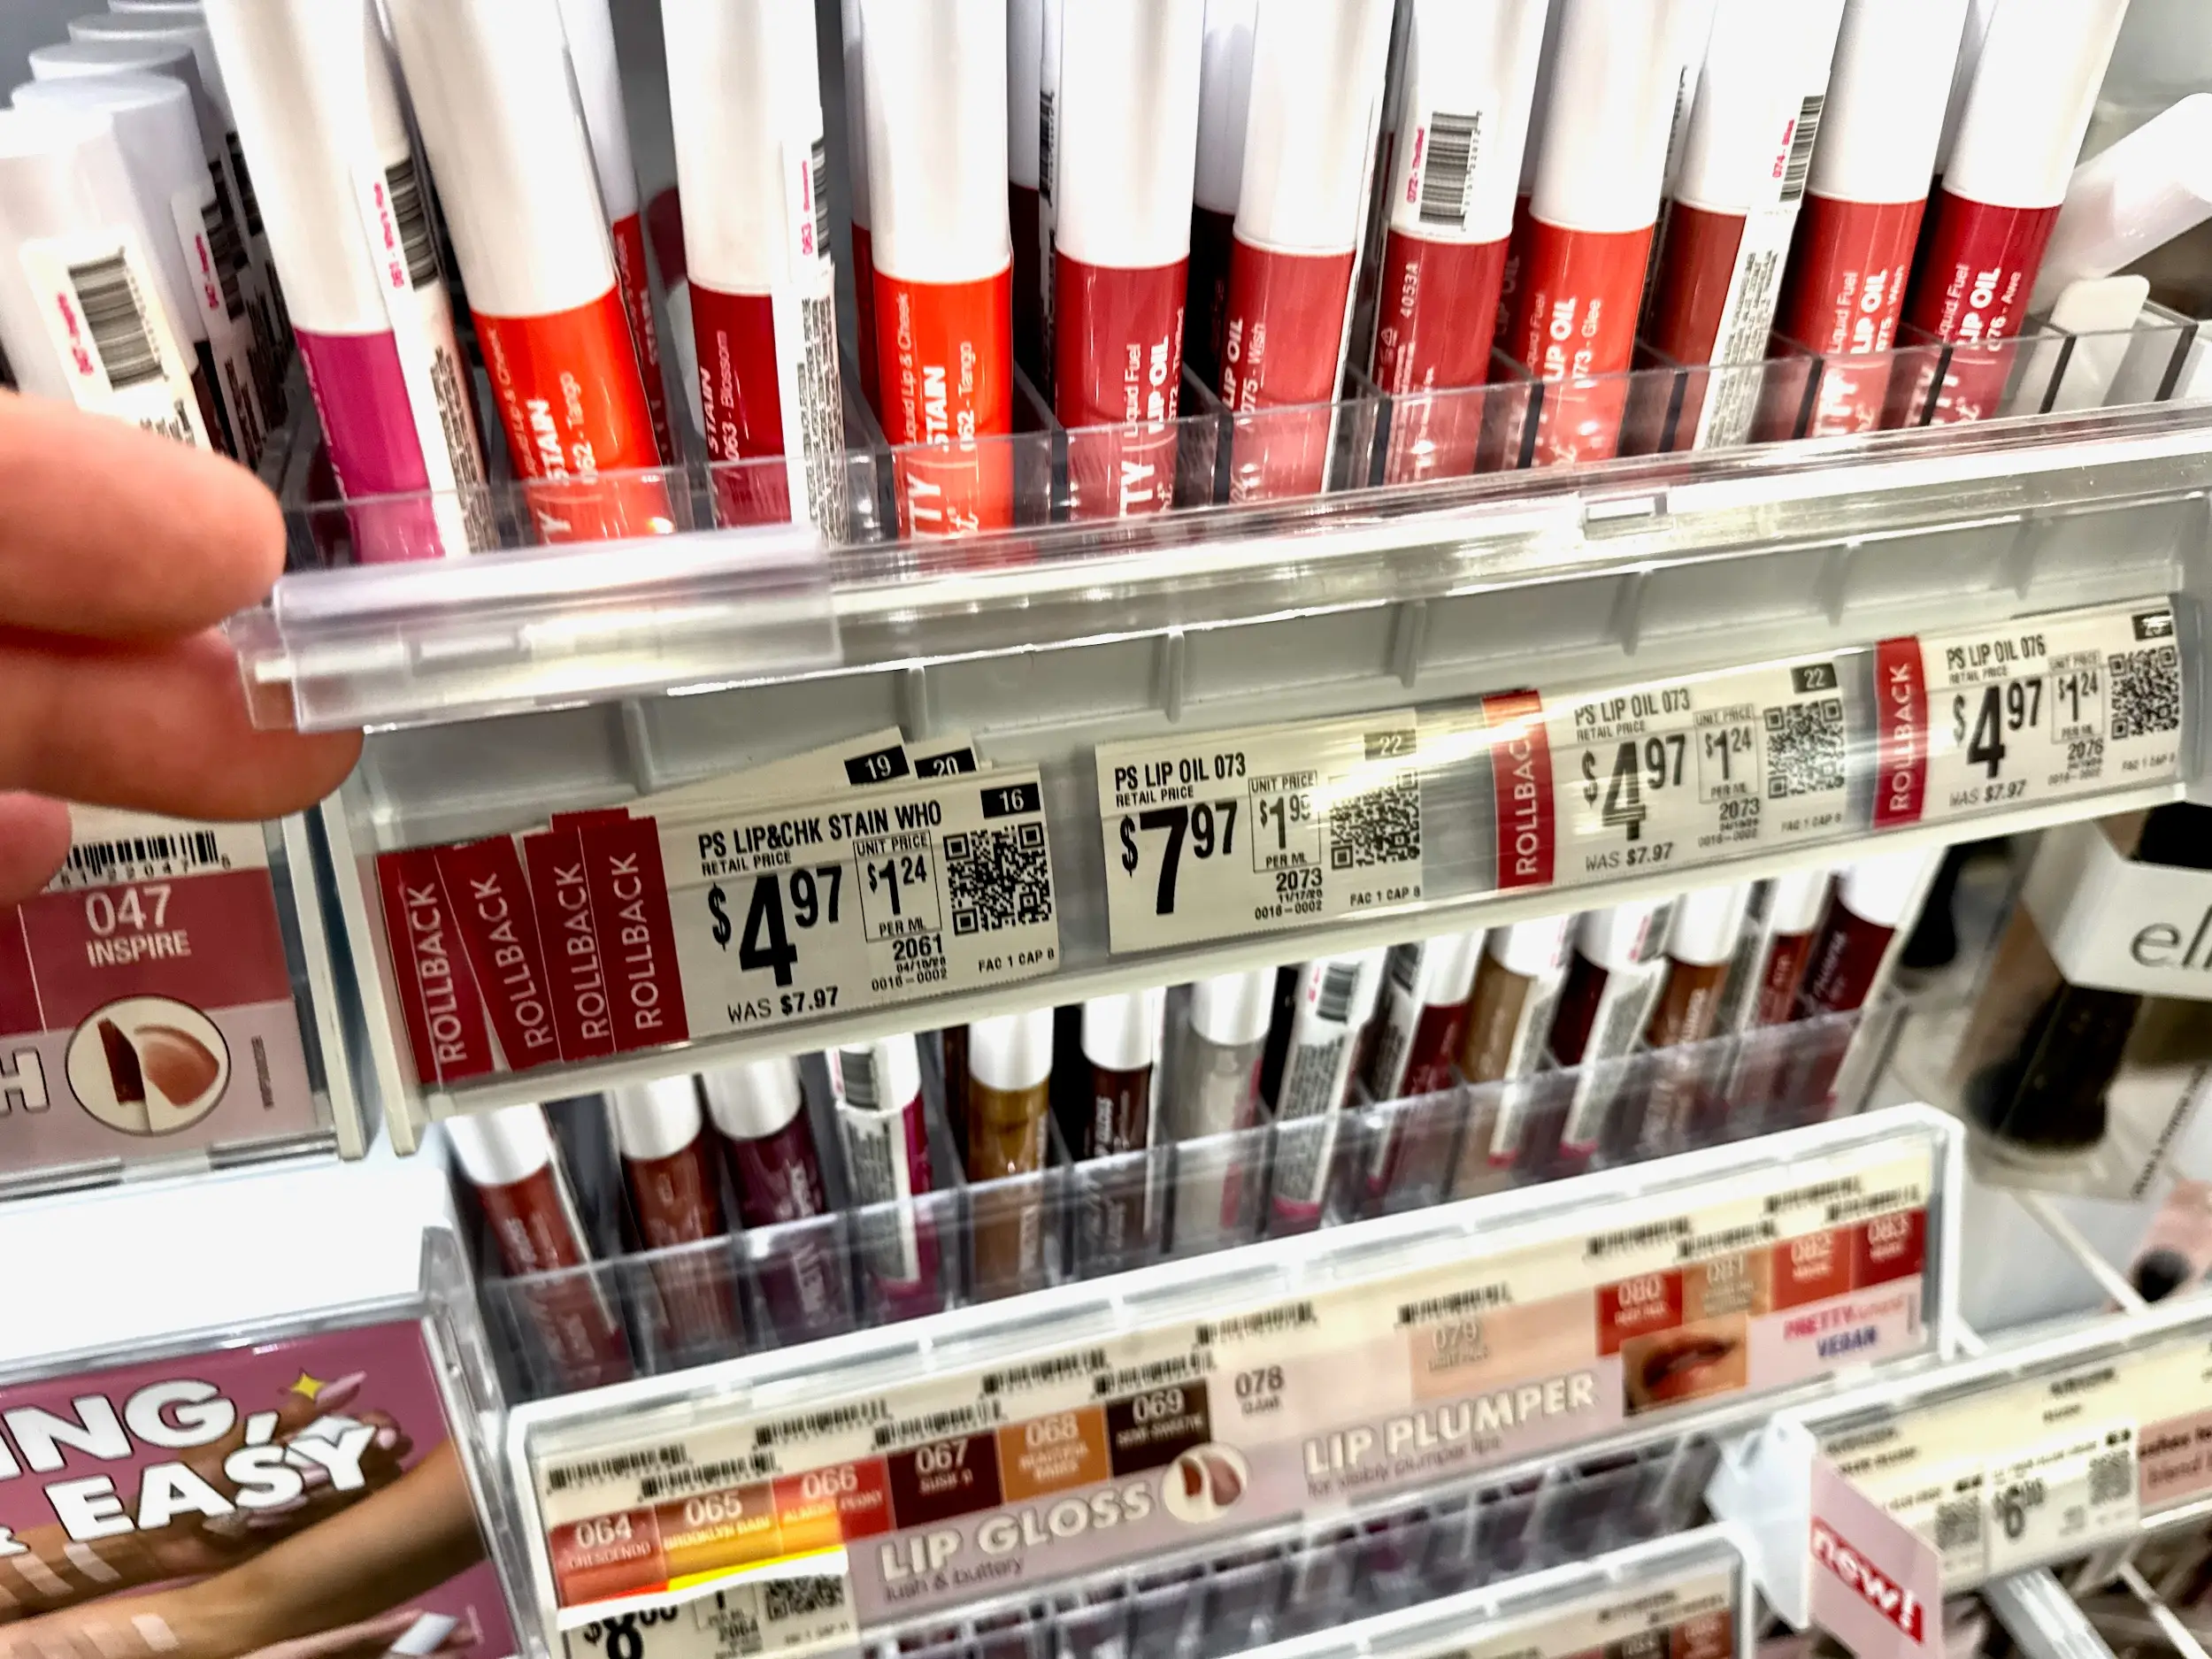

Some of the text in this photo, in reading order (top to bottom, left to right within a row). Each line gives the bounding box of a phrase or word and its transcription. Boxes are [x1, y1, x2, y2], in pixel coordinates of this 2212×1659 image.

[1400, 261, 1418, 319] 4053A
[1836, 271, 1858, 305] Fuel
[1947, 264, 1970, 299] Fuel
[896, 293, 911, 350] Cheek
[1530, 293, 1546, 329] Fuel
[1582, 299, 1601, 338] Glee
[1851, 269, 1887, 354] LIP OIL
[1955, 267, 2001, 350] LIP OIL
[1542, 297, 1577, 382] LIP OIL
[1986, 315, 2007, 352] 076
[899, 355, 912, 366] &
[957, 341, 976, 394] Tango
[1222, 318, 1243, 409] LIP OIL
[1240, 322, 1264, 414] 075 Wish
[559, 372, 584, 431] Tango
[717, 330, 740, 462] 063 Blossom
[899, 371, 917, 396] Lip
[1123, 343, 1141, 437] Liquid Fuel
[1147, 335, 1169, 434] LIP OIL
[700, 365, 719, 453] STAIN
[923, 365, 950, 453] STAIN
[526, 398, 570, 487] STAIN
[1947, 634, 2047, 671] PS LIP OIL 076
[1804, 668, 1826, 690] 22
[1574, 687, 1691, 727] PS LIP OIL 073
[1379, 734, 1402, 757] 22
[1577, 719, 1646, 742] RETAIL PRICE
[1888, 663, 1913, 811] ROLLBACK
[864, 755, 893, 780] 19
[933, 756, 960, 777] 20
[1115, 752, 1247, 792] PS LIP OIL 073
[1251, 772, 1314, 794] UNIT PRICE
[999, 788, 1025, 812] 16
[1116, 785, 1194, 809] RETAIL PRICE
[1513, 721, 1539, 877] ROLLBAC
[1719, 796, 1761, 821] 2073
[1984, 780, 2027, 803] $7.97
[698, 799, 941, 860] PS LIP&CHK STAIN WHO
[857, 832, 928, 857] UNIT PRICE
[702, 849, 792, 878] RETAIL PRICE
[1265, 853, 1288, 868] PER
[1586, 841, 1674, 872] WAS $7.97
[1276, 867, 1324, 893] 2073
[1350, 892, 1372, 907] FAC
[1386, 886, 1409, 901] CAP
[85, 884, 172, 937] 047
[879, 916, 926, 938] PER ML
[86, 929, 192, 968] INSPIRE
[553, 862, 611, 1041] ROLLBACK
[609, 852, 664, 1030] ROLLBACK
[892, 933, 943, 962] 2061
[406, 882, 469, 1064] ROLLBACK
[470, 872, 554, 1049] ROLLBACK
[979, 948, 1043, 973] FAC CAP
[727, 985, 839, 1025] WAS $7.97
[1432, 1322, 1483, 1351] 079
[1234, 1365, 1286, 1397] 078
[1133, 1387, 1186, 1425] 069
[1303, 1372, 1595, 1476] LIP PLUMPER
[1025, 1413, 1079, 1448] 068
[915, 1438, 970, 1476] 067
[42, 1421, 379, 1543] EASY
[802, 1464, 858, 1500] 066
[684, 1490, 743, 1527] 065
[575, 1512, 634, 1549] 064
[880, 1481, 1153, 1582] LIP GLOSS
[1812, 1527, 1917, 1631] new!
